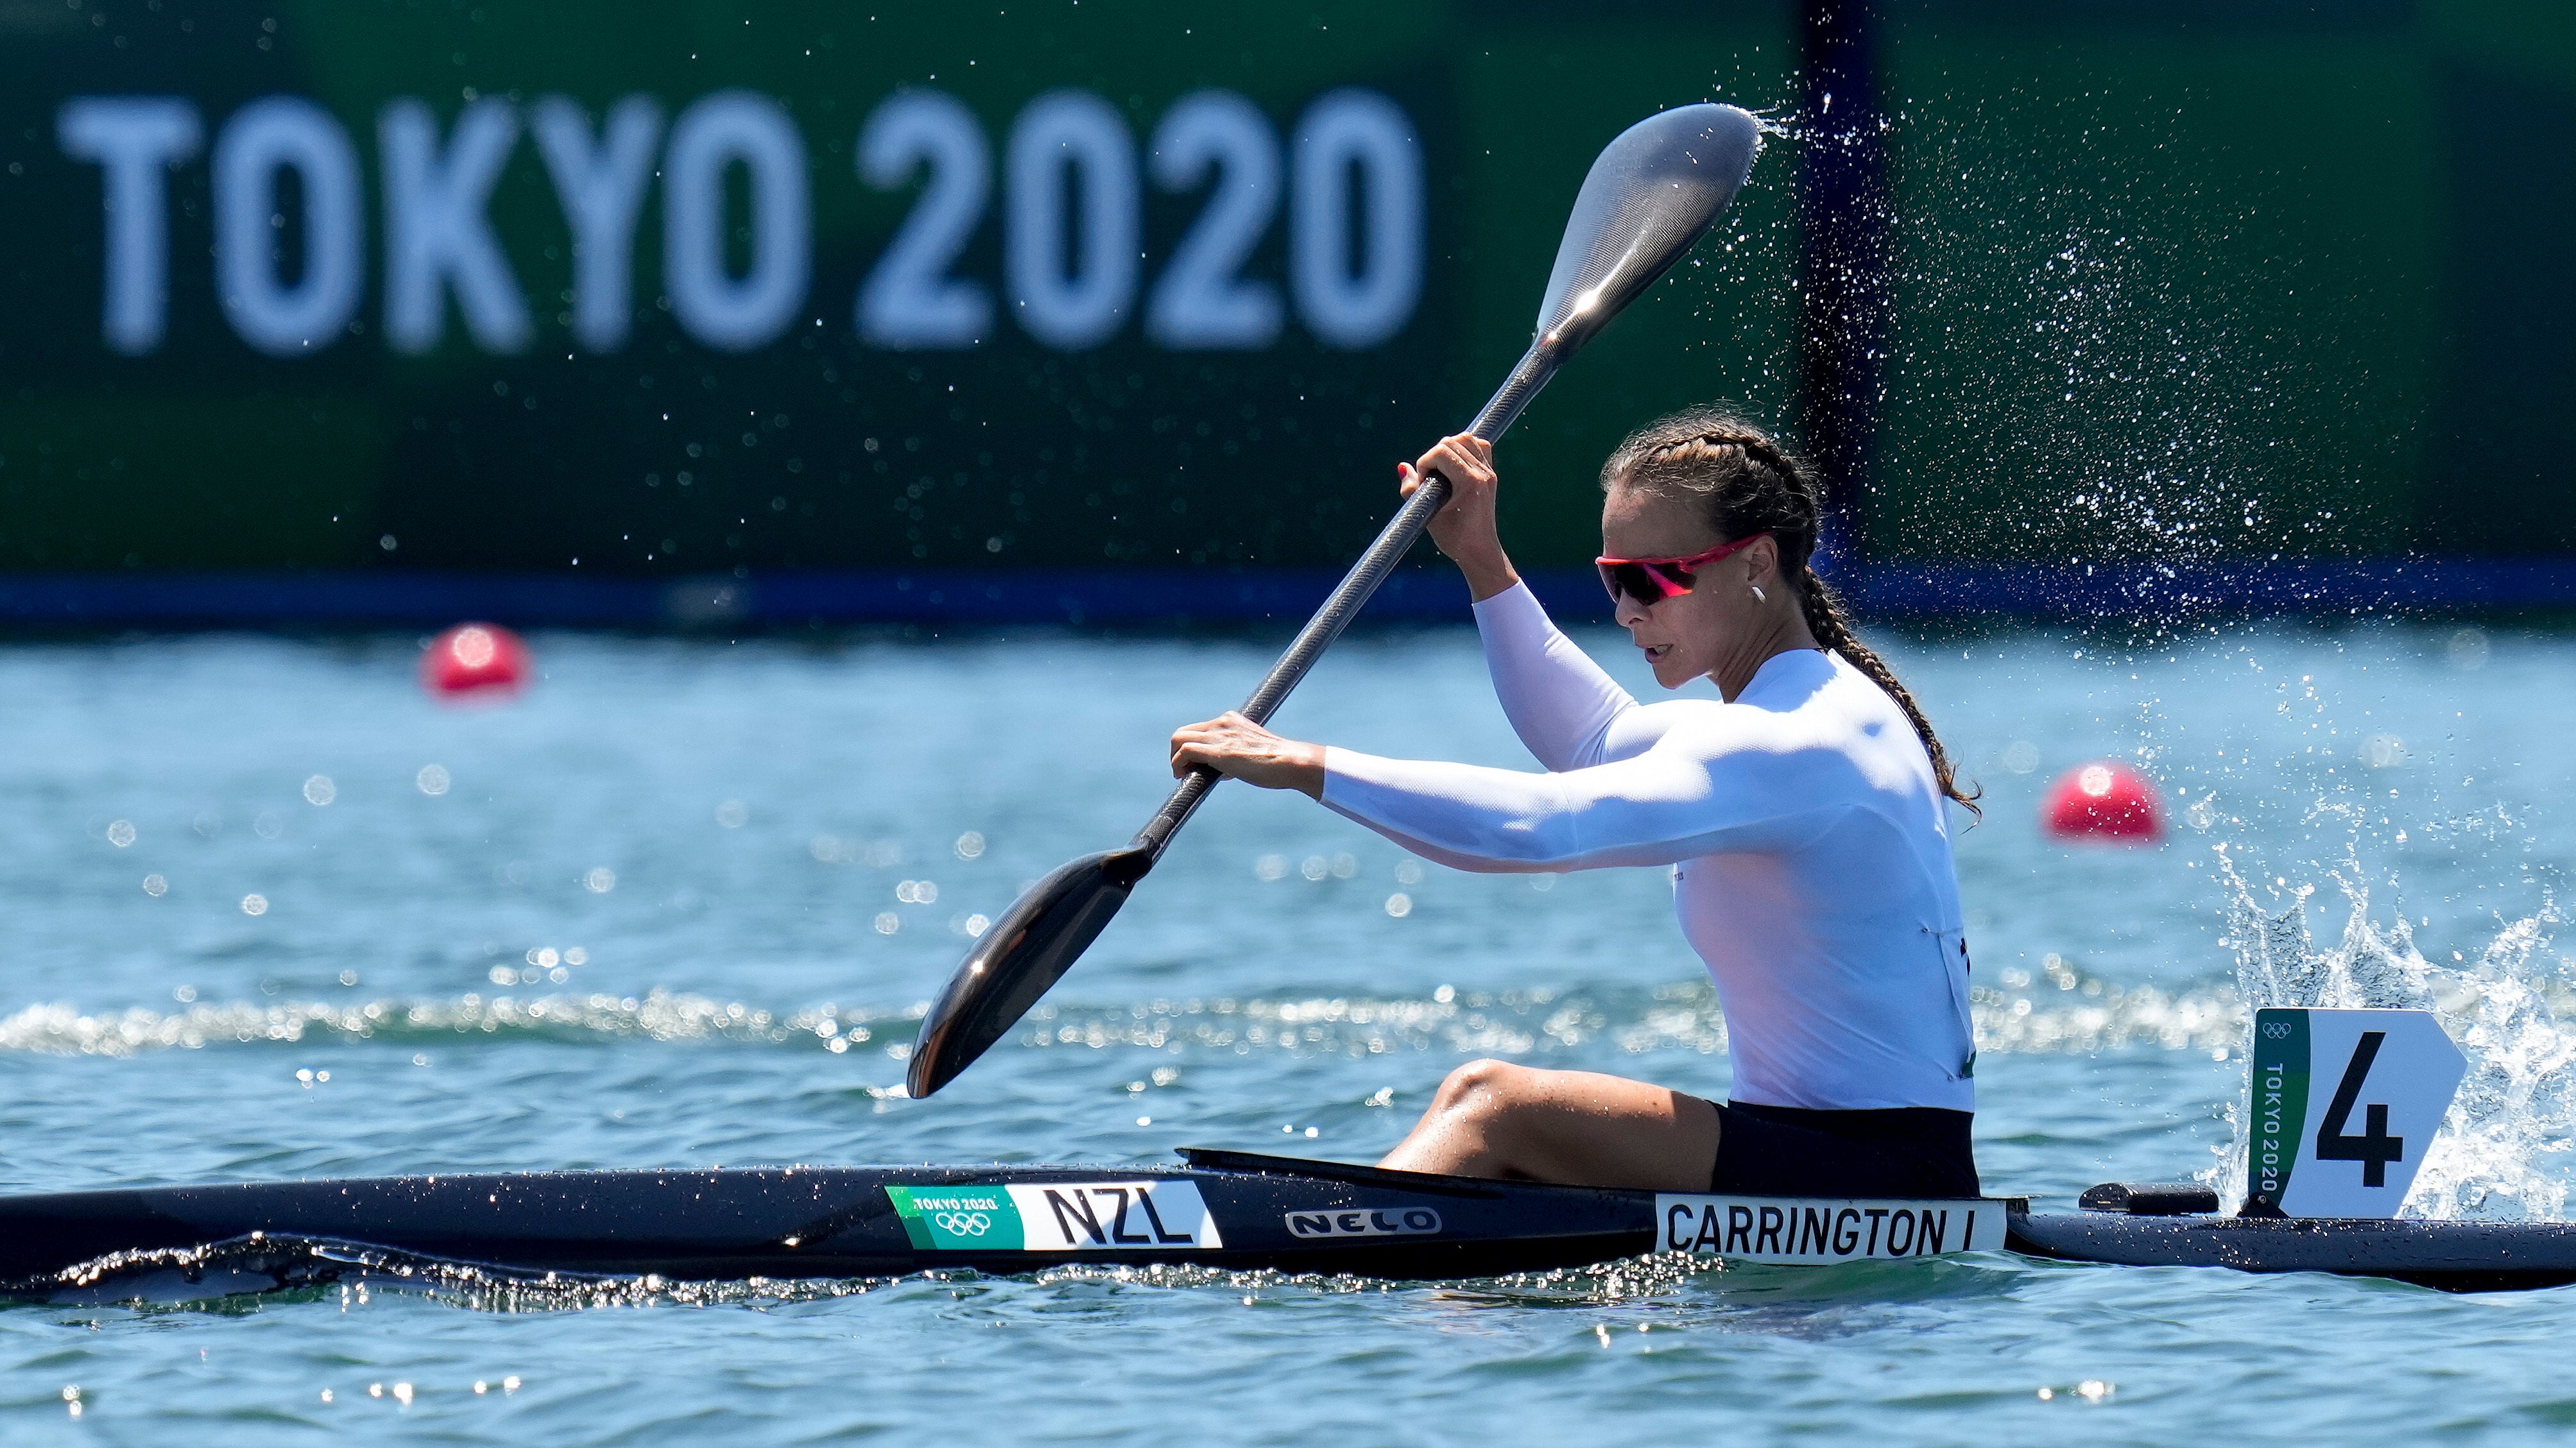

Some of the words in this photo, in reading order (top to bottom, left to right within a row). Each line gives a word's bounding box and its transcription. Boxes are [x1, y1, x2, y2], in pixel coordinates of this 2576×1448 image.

[63, 96, 806, 346] TOKYO
[863, 96, 1416, 342] 2020
[2263, 1062, 2283, 1134] TOKYO
[2315, 1032, 2403, 1188] 4
[2262, 1139, 2280, 1192] 2020
[913, 1197, 961, 1210] TOKYO
[961, 1197, 996, 1210] 2020
[1043, 1187, 1194, 1245] NZL
[1292, 1211, 1437, 1234] NELO
[1667, 1204, 1947, 1256] CARRINGTON
